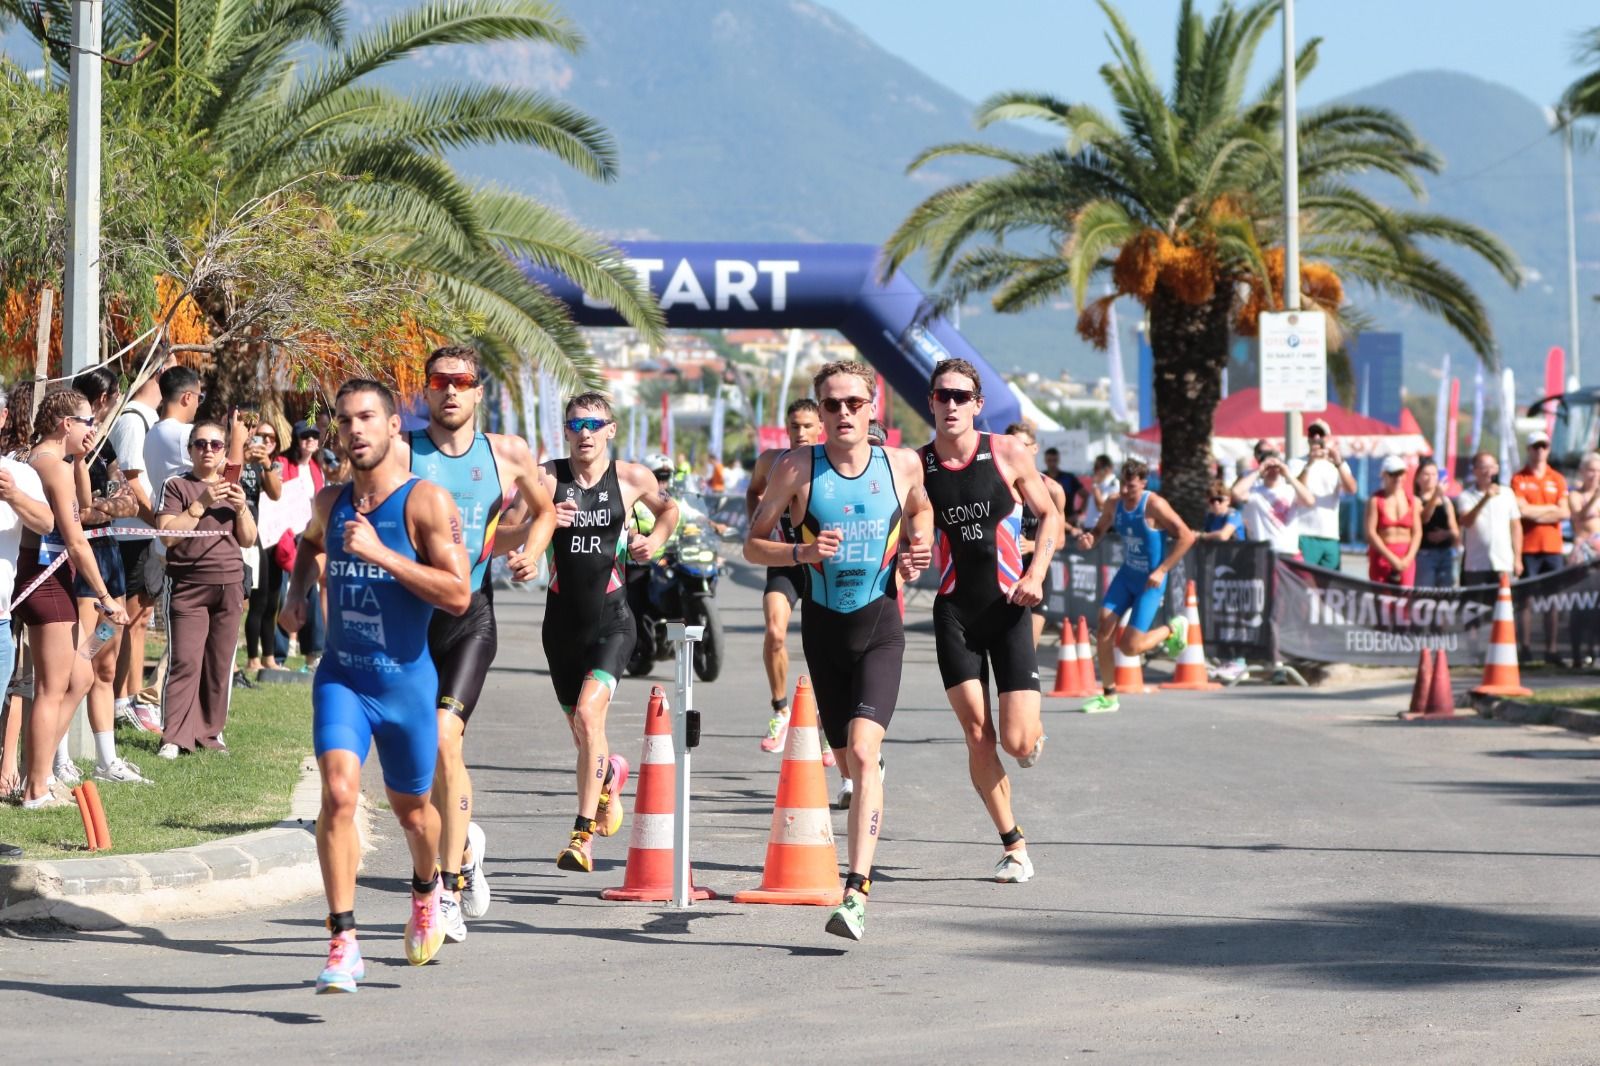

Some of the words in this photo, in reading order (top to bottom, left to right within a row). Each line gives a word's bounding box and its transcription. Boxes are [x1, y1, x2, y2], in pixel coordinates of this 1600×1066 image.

[583, 257, 800, 311] TART
[941, 501, 991, 526] LEONOV
[960, 523, 984, 542] RUS
[570, 536, 602, 554] BLR
[828, 542, 877, 565] BEL
[330, 560, 395, 580] STATEF
[339, 583, 381, 609] ITA
[1306, 587, 1460, 627] TRIATLON
[1346, 631, 1458, 652] FEDERASYONU
[353, 655, 401, 667] REALE
[460, 799, 468, 811] 3
[870, 813, 879, 836] 48
